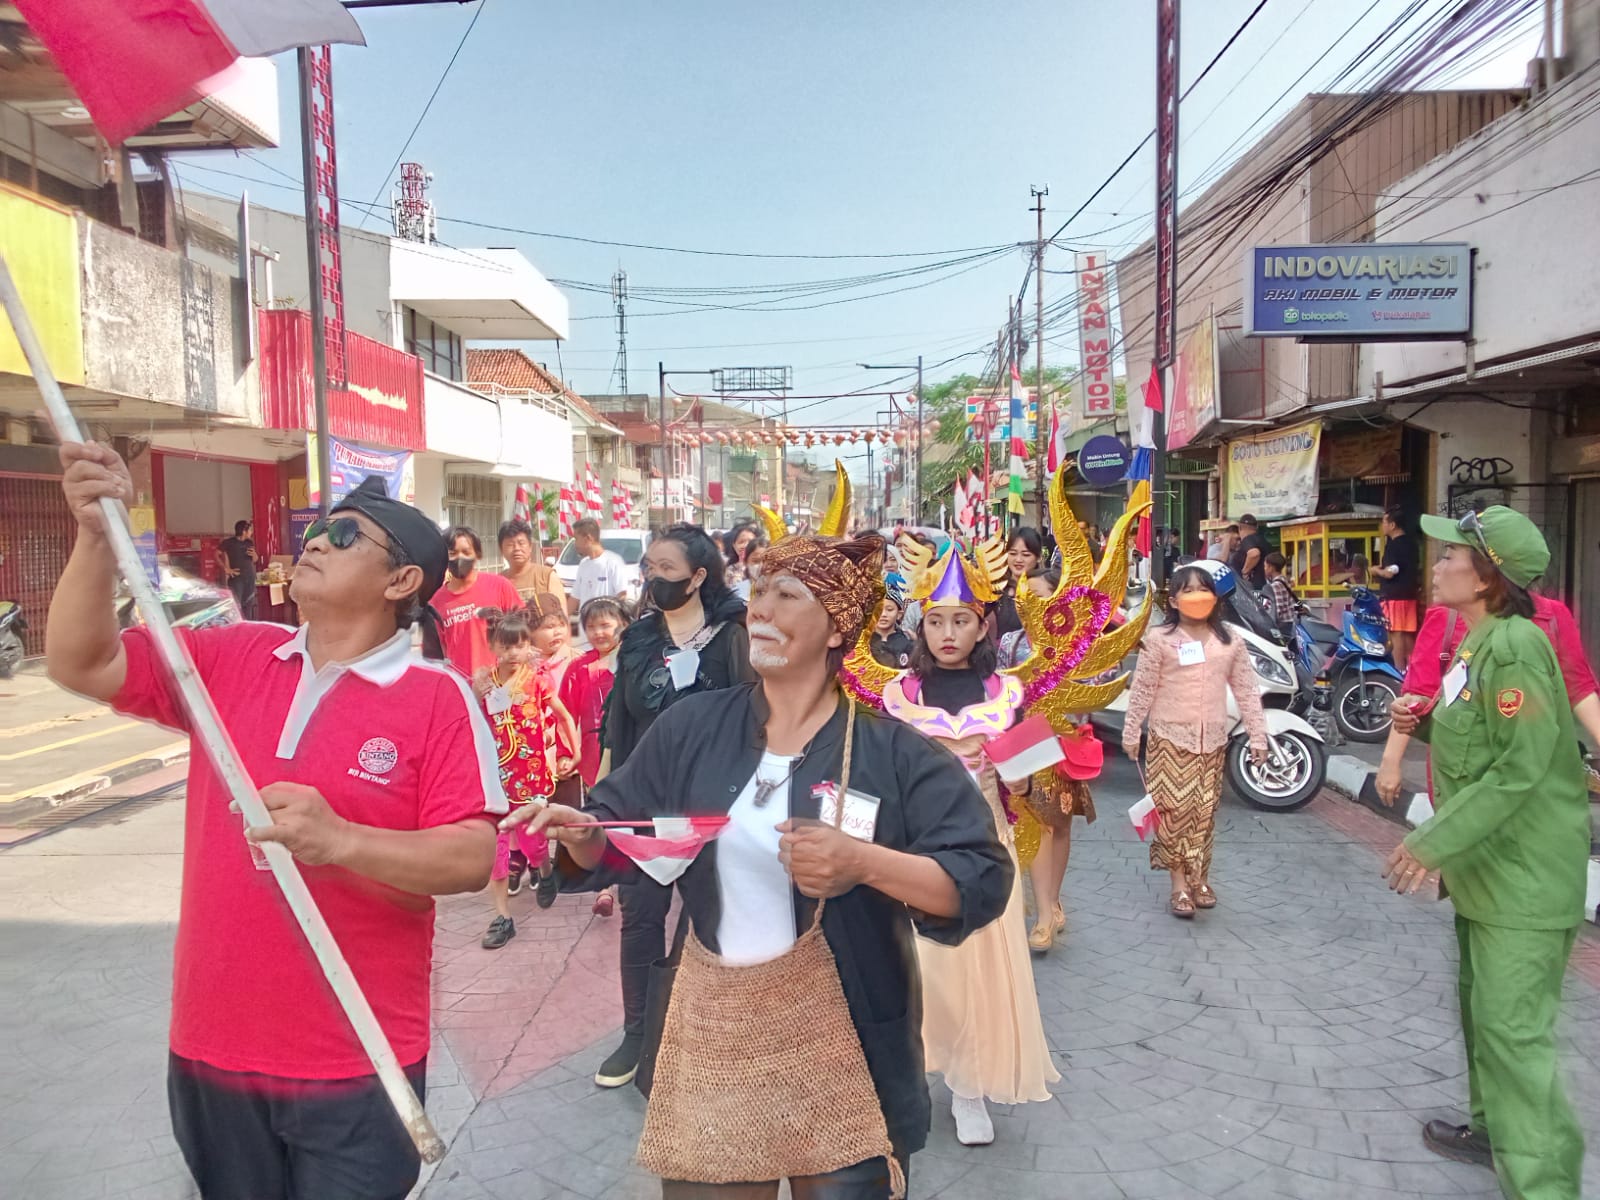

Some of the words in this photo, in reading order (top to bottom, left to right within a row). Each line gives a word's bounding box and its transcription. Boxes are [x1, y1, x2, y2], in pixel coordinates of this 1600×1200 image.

[1264, 255, 1458, 285] INDOVARIASI
[1081, 255, 1107, 331] INTAN
[1264, 288, 1297, 301] AKI
[1302, 288, 1361, 301] MOBIL
[1388, 287, 1458, 301] MOTOR
[1084, 338, 1111, 412] MOTOR
[1232, 443, 1261, 461] SOTO
[1264, 431, 1315, 457] KUNING
